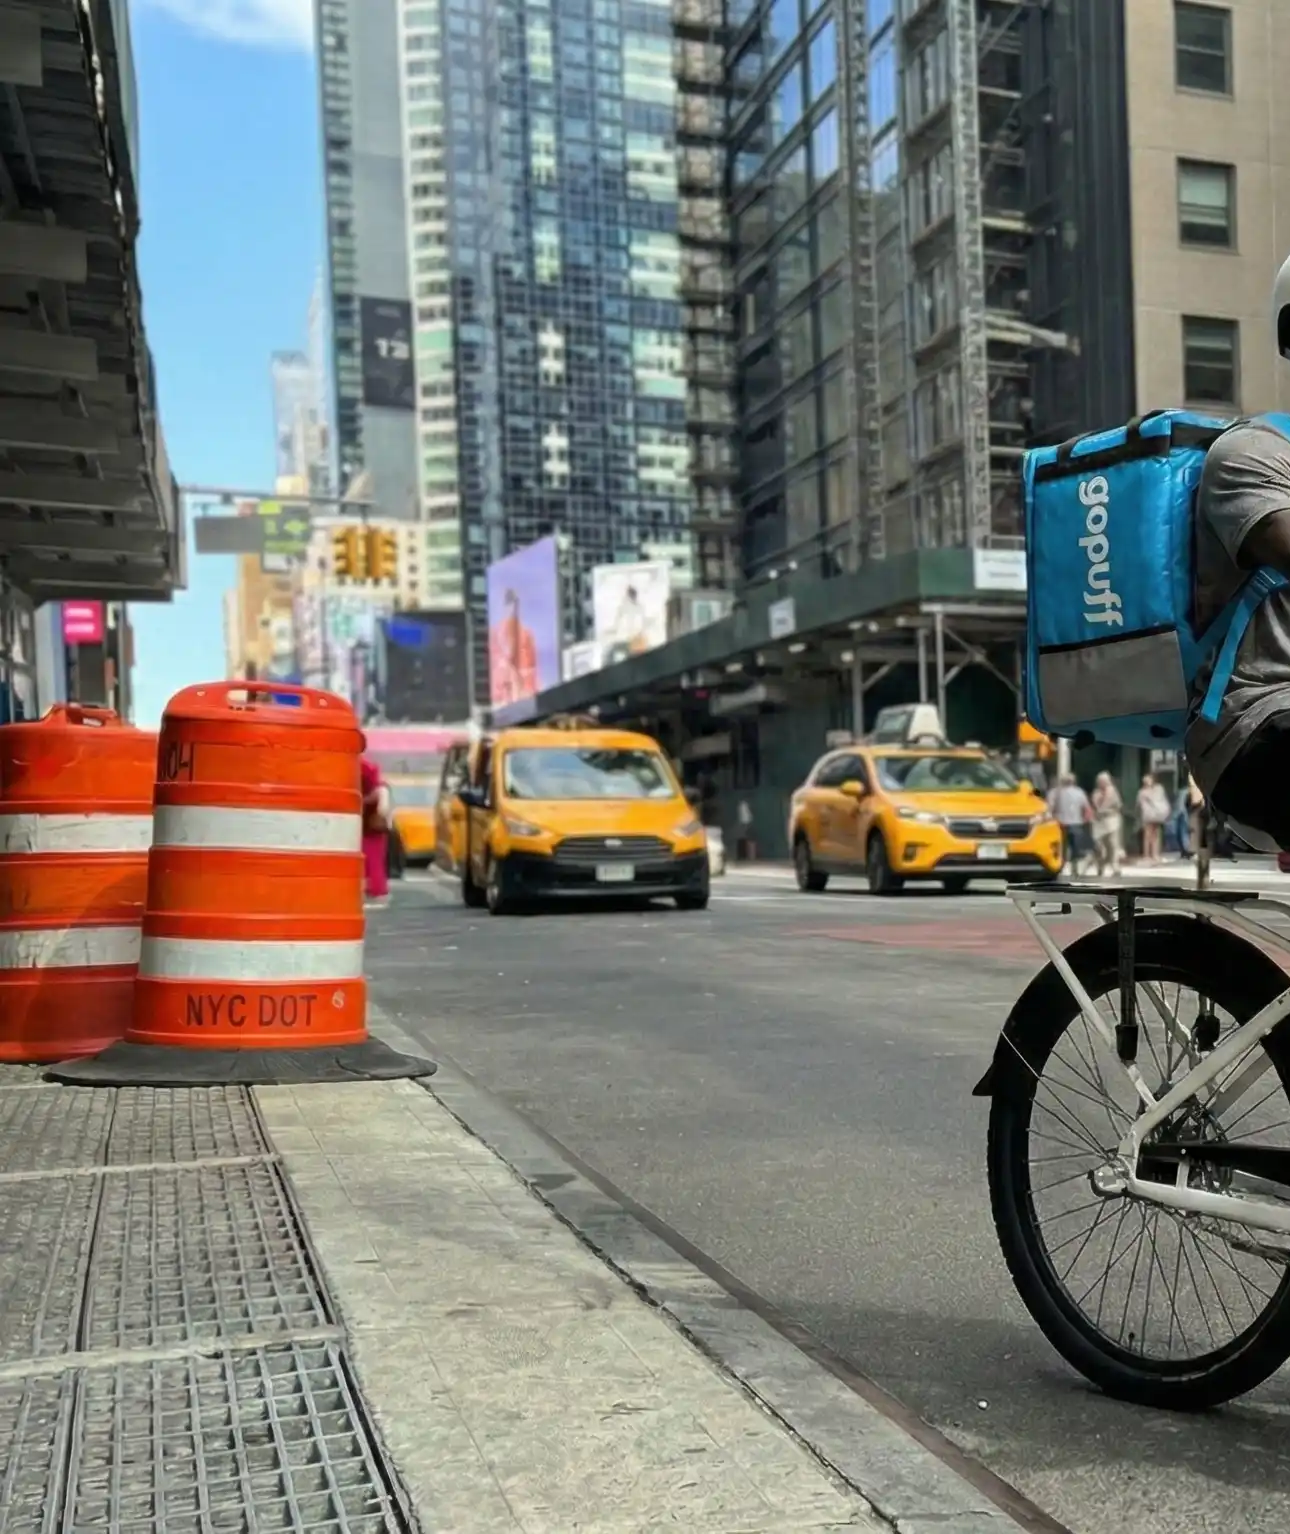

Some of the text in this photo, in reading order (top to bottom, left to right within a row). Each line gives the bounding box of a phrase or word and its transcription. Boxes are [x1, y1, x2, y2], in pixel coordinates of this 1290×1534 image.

[1079, 475, 1124, 627] gopuff
[186, 993, 317, 1027] NYC DOT
